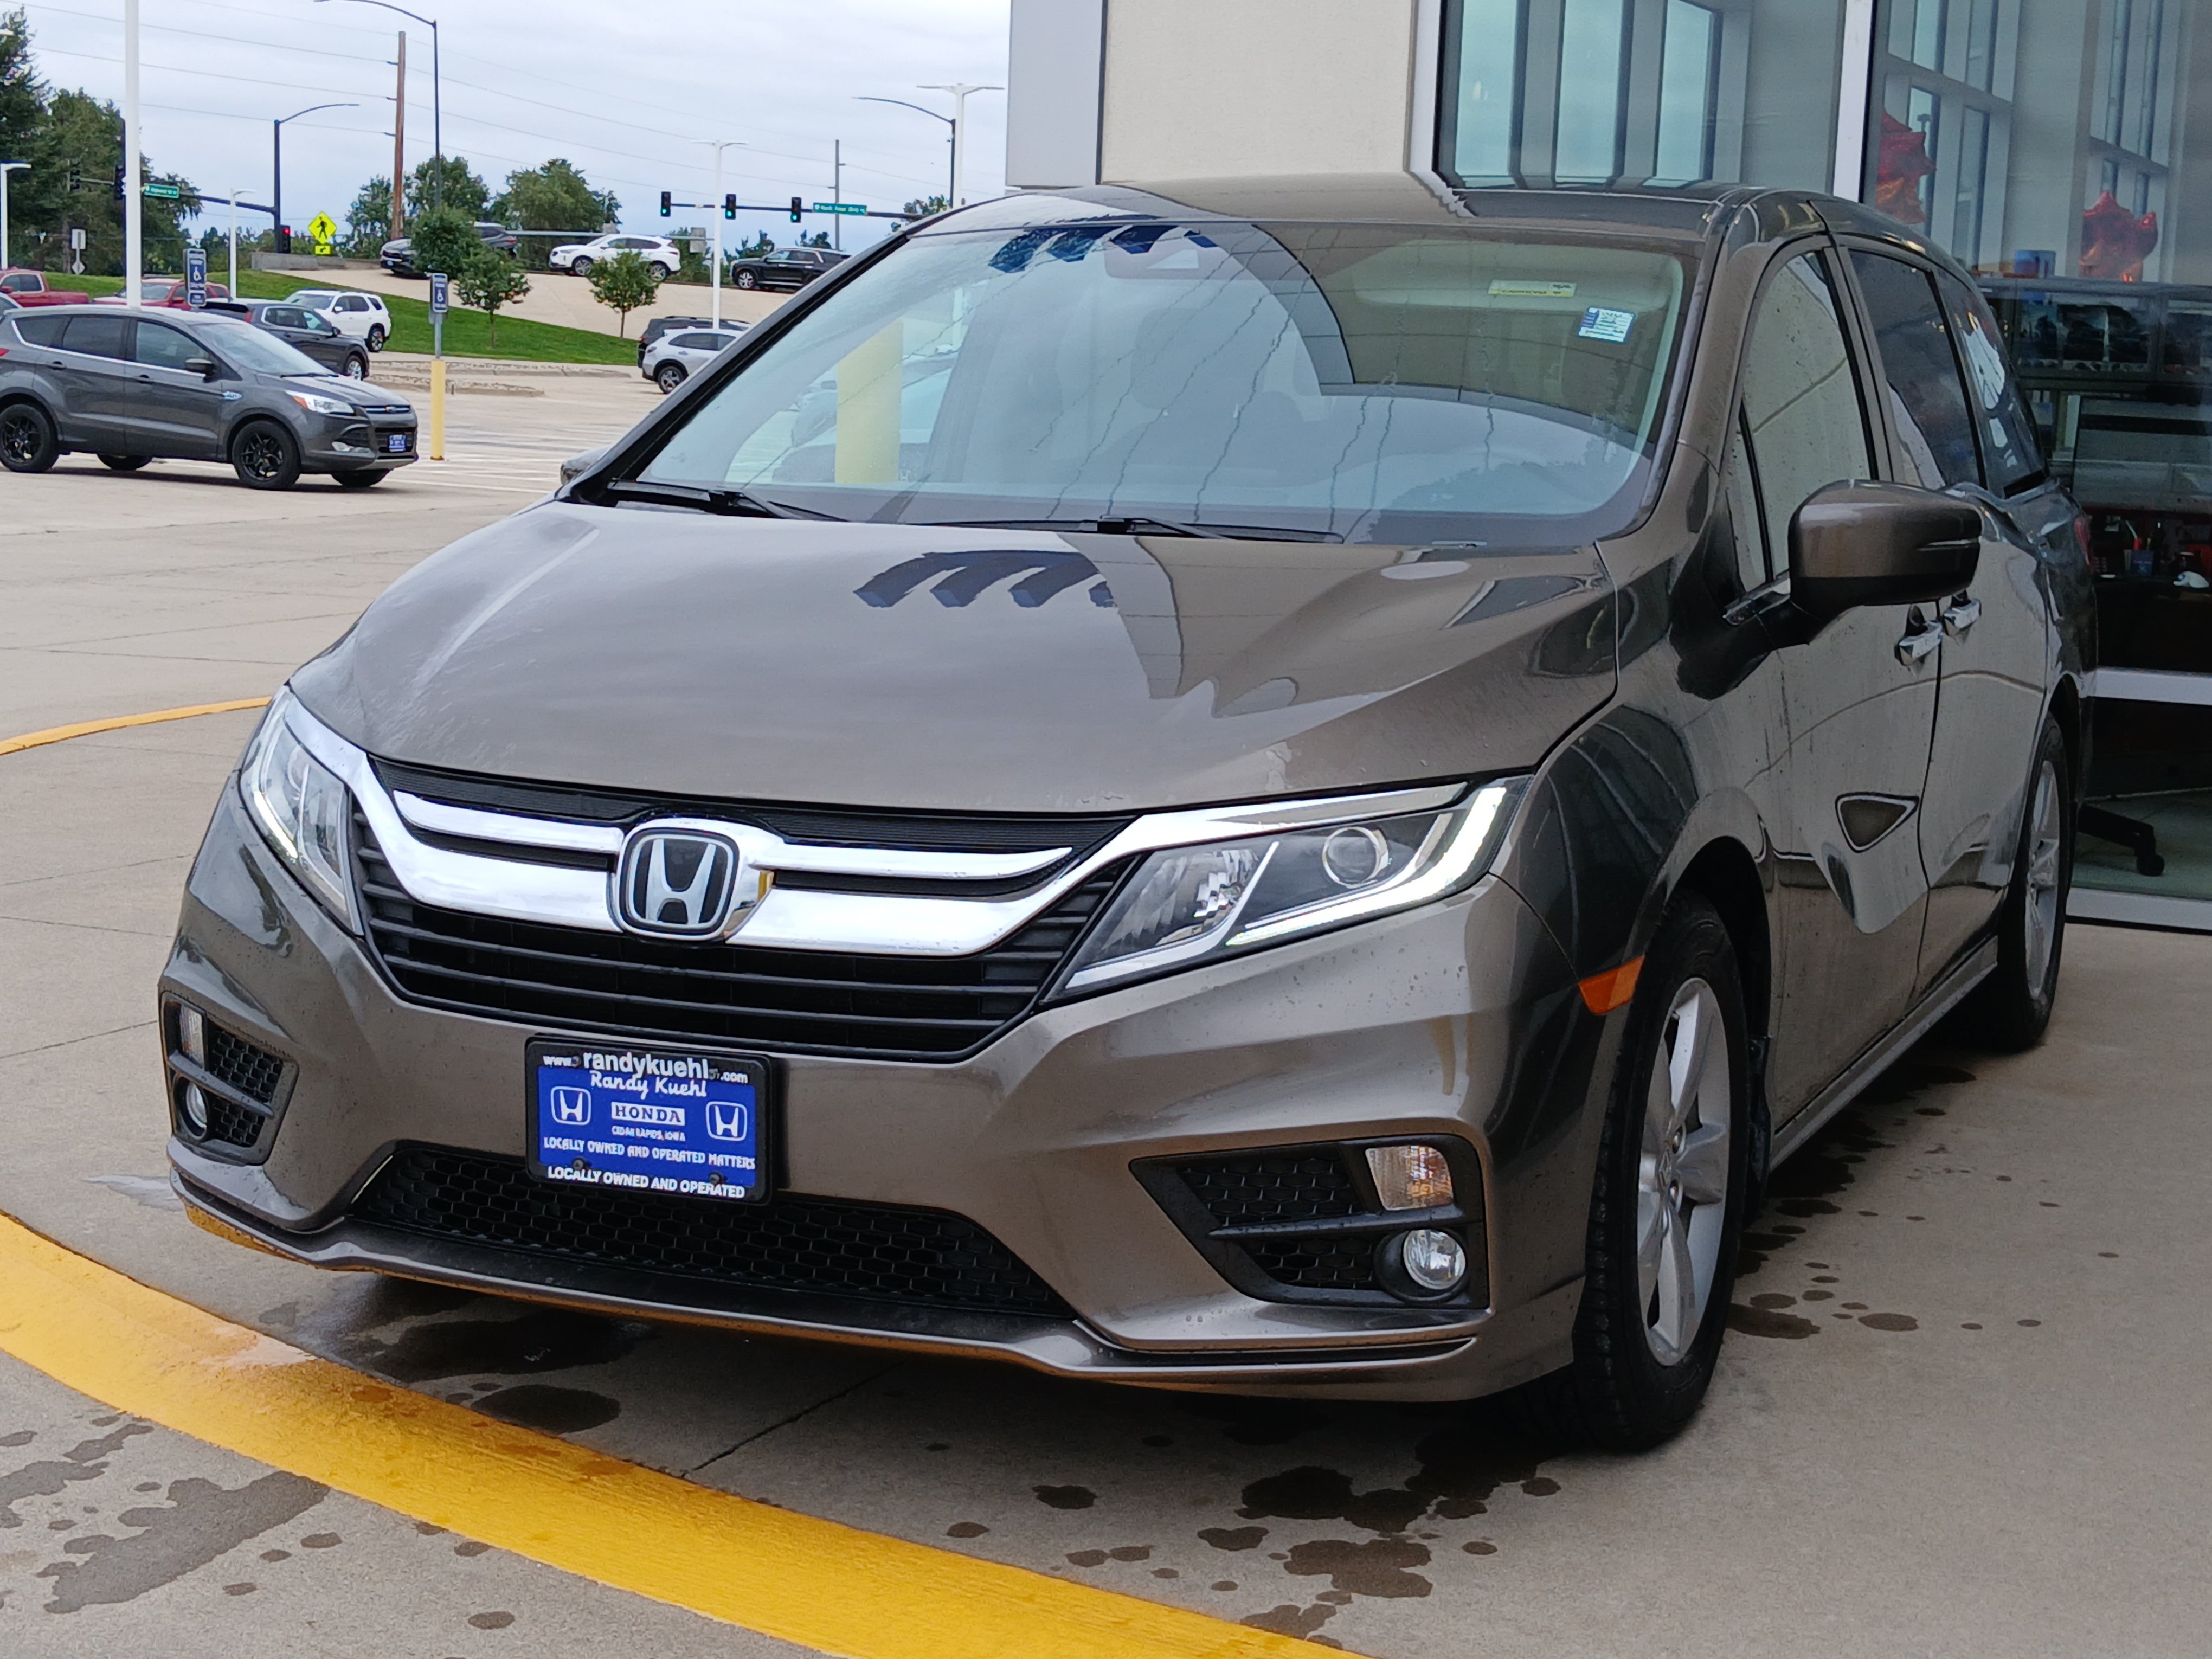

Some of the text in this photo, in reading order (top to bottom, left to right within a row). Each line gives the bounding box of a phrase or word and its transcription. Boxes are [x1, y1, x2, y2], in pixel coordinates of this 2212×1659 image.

[589, 1070, 707, 1100] Randy Kuehl
[615, 1105, 681, 1123] HONDA
[544, 1137, 755, 1170] LOCALLY OWNED AND OPERATED MATTERS
[548, 1166, 745, 1198] LOCALLY OWNED AND OPERATED
